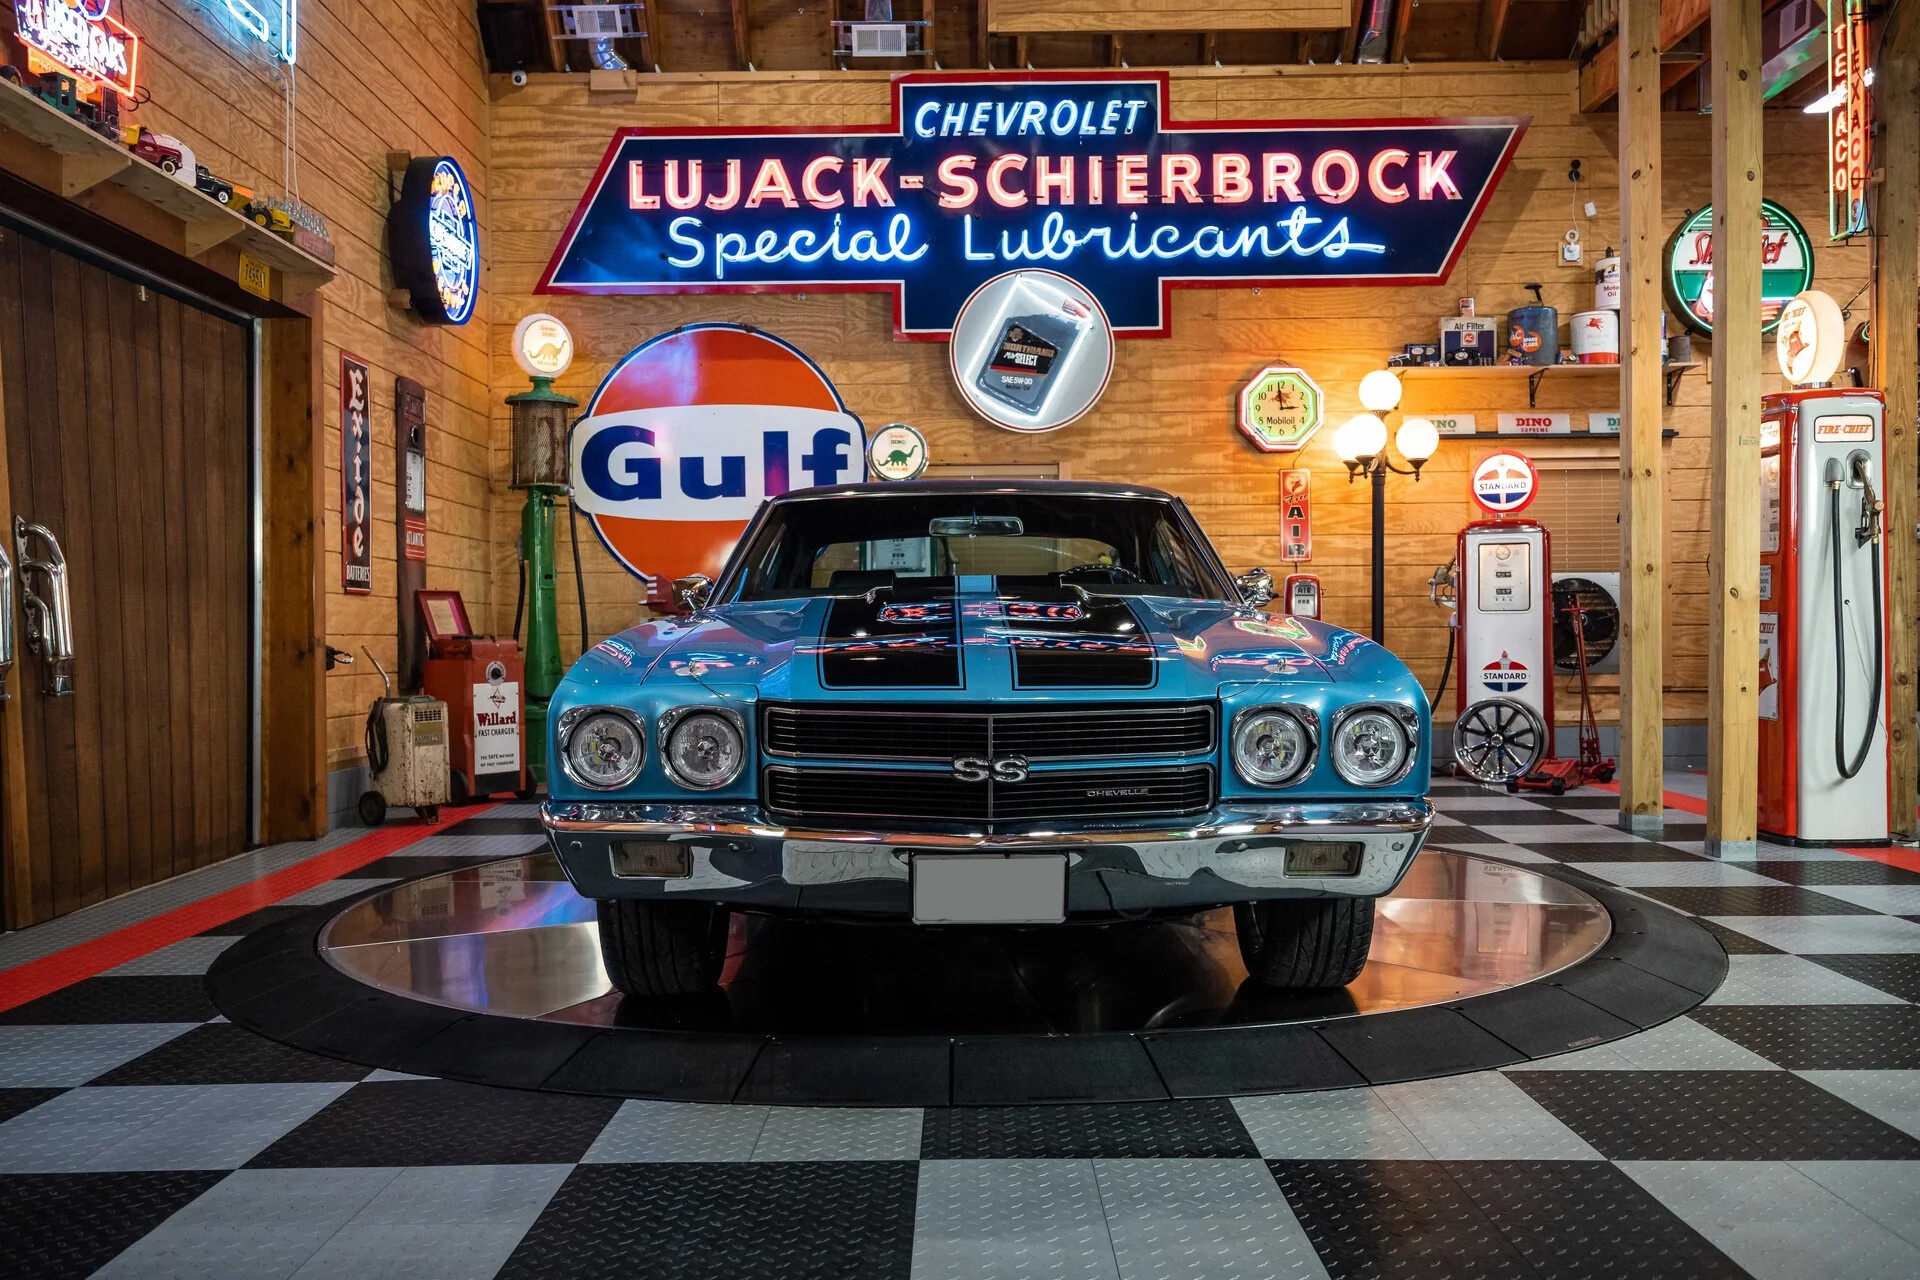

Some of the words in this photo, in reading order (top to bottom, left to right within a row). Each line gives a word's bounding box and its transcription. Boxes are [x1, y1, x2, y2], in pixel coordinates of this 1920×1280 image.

[915, 98, 1148, 138] CHEVROLET
[628, 148, 1464, 211] LUJACK-SCHIERBROCK
[667, 212, 931, 280] Special
[964, 205, 1387, 261] Lubricants
[1466, 322, 1485, 330] Filter
[1014, 352, 1039, 367] SELECT
[1001, 375, 1013, 384] SAE
[1266, 416, 1296, 425] Mobiloil
[1516, 417, 1553, 427] DINO
[581, 424, 852, 502] Gulf
[1480, 481, 1527, 491] STANDARD
[1288, 505, 1305, 557] AIR
[346, 563, 370, 582] BATTERIES
[1483, 672, 1527, 680] STANDARD
[476, 711, 517, 727] Willard
[478, 729, 490, 737] FAST
[491, 727, 515, 736] CHARGER
[951, 753, 1030, 783] SS
[1086, 788, 1149, 797] CHEVELLE
